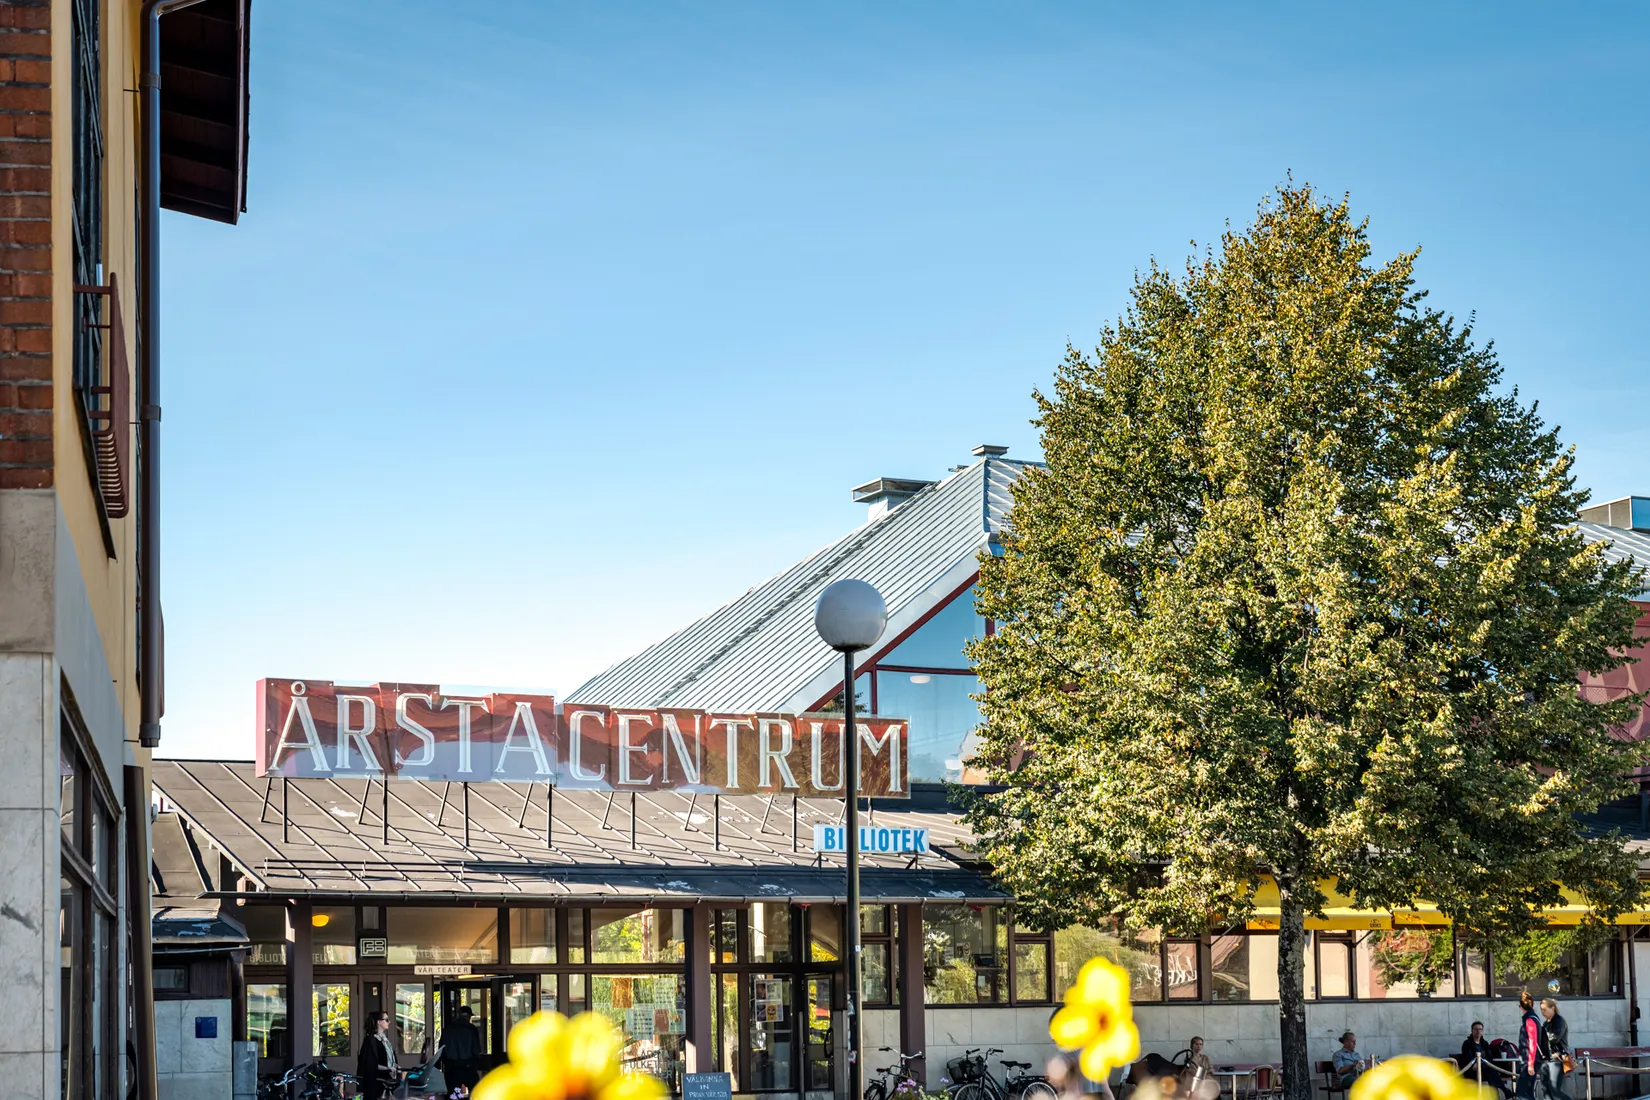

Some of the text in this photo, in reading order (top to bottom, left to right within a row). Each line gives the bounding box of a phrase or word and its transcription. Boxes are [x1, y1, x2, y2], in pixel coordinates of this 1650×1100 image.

[268, 681, 903, 792] ÅRSTA CENTRUM
[824, 828, 926, 852] BILIOTEK
